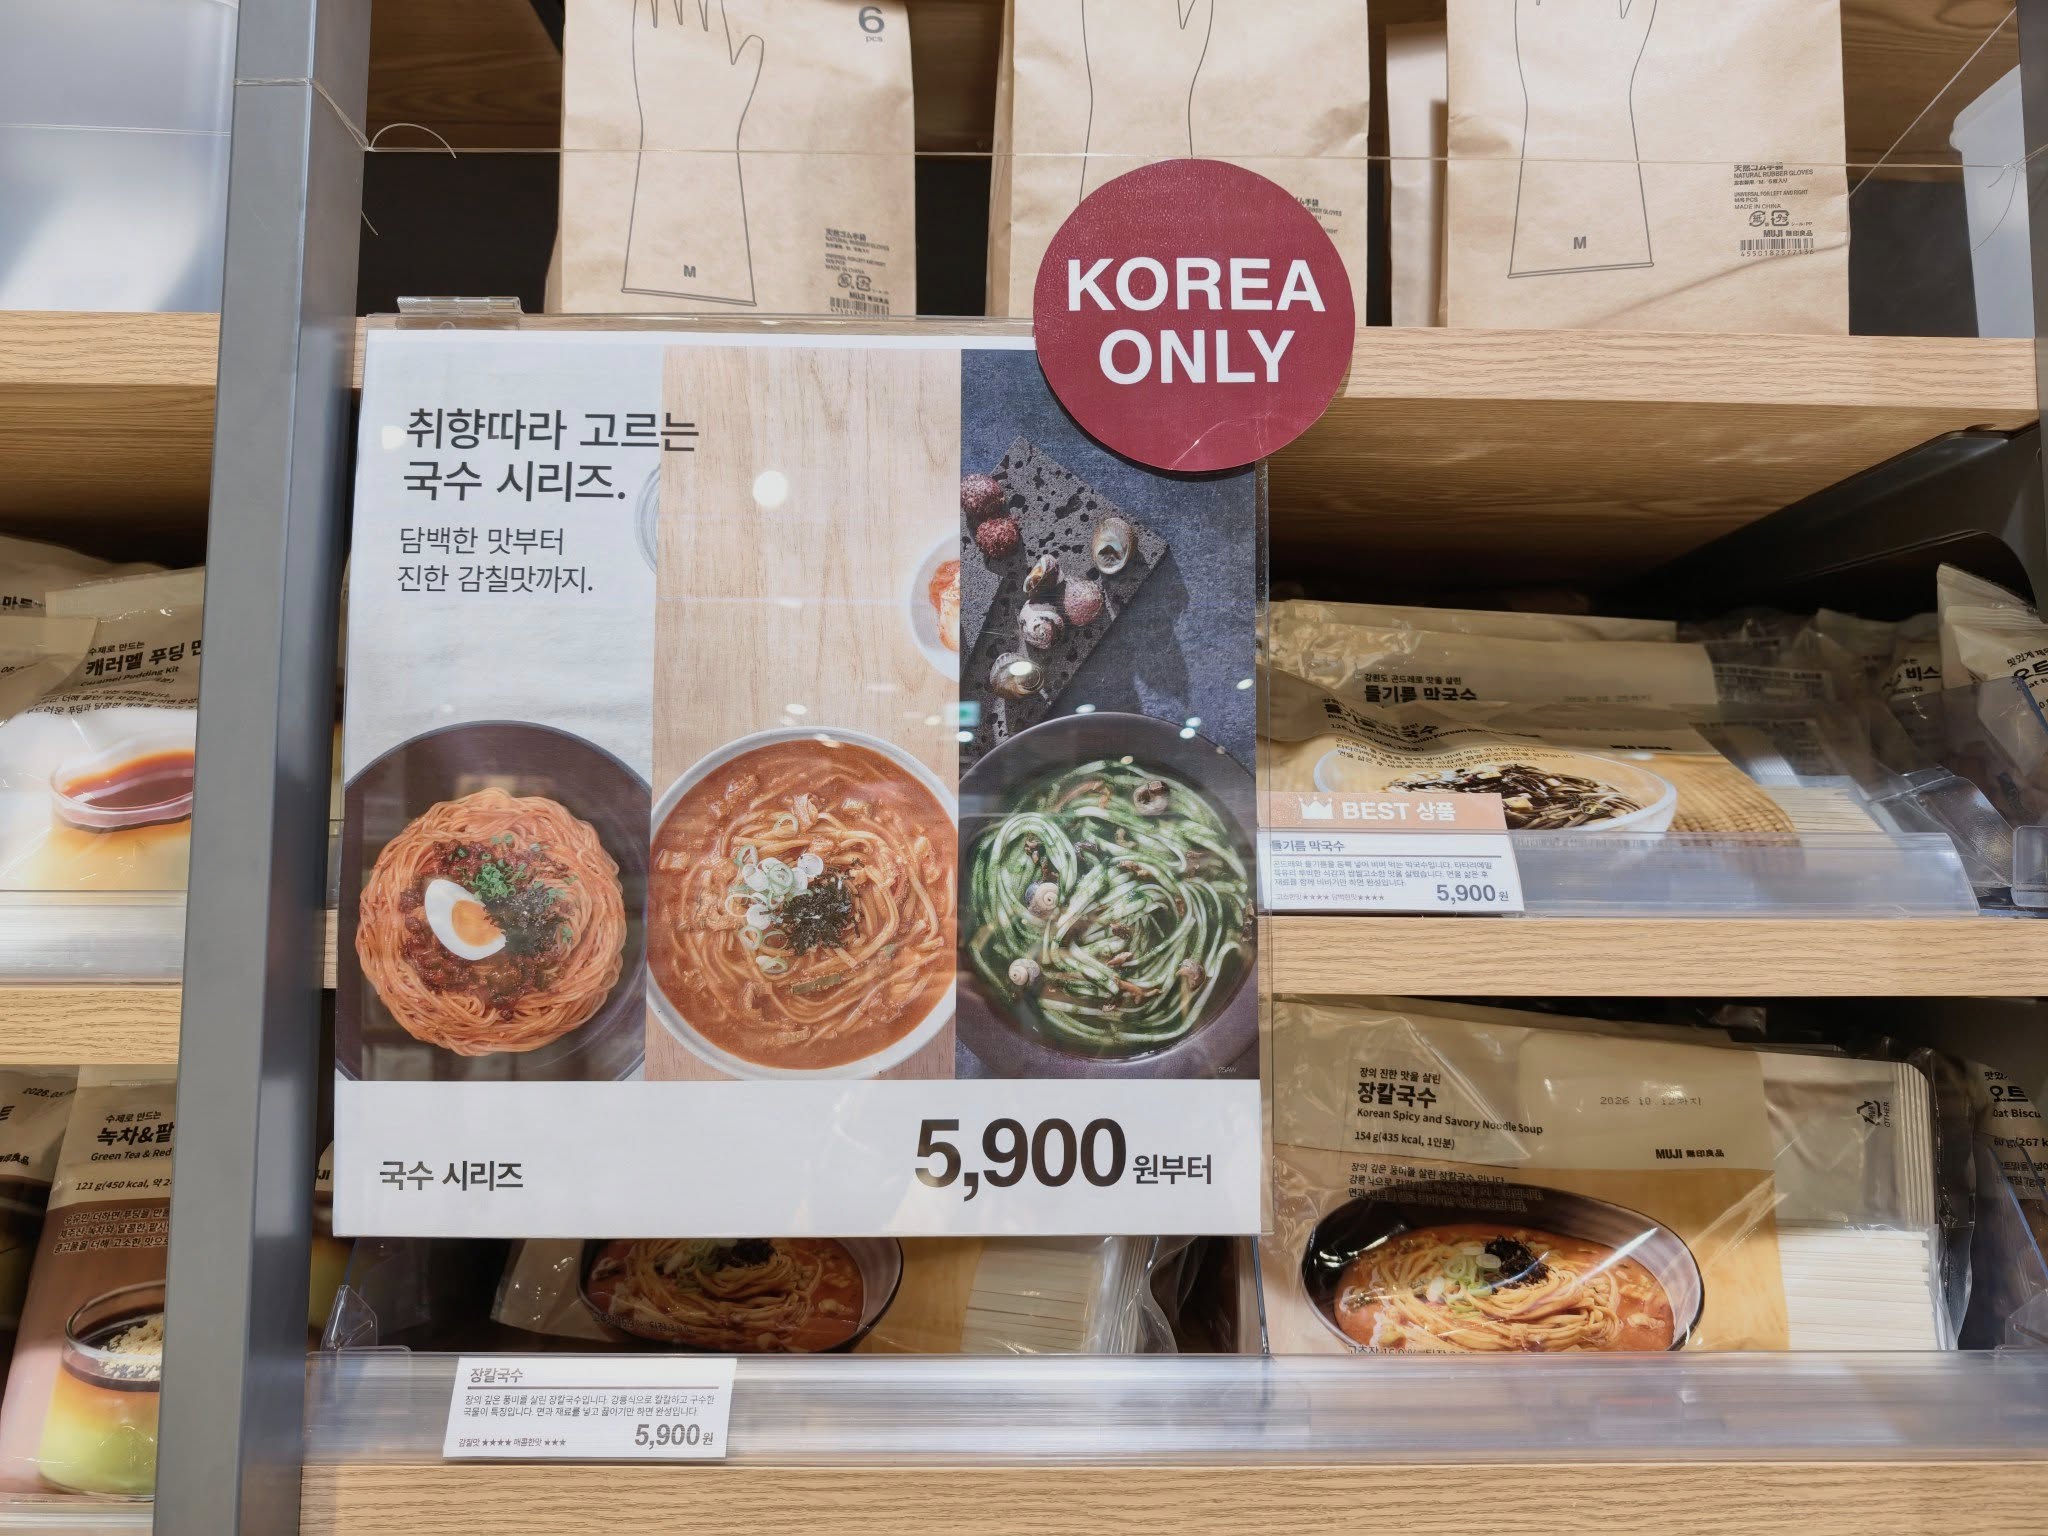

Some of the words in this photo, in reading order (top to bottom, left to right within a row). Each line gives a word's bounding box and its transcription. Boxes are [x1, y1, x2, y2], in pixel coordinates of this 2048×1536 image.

[858, 6, 885, 34] 6
[1762, 170, 1789, 178] RUBBER
[1763, 230, 1783, 238] MUJI
[1573, 236, 1587, 250] M
[683, 265, 697, 278] M
[1068, 256, 1326, 312] KOREA
[1098, 329, 1296, 385] ONLY
[406, 408, 568, 450] 취향따라
[580, 412, 700, 452] 고르는
[404, 461, 483, 502] 국수
[496, 460, 626, 502] 시리즈.
[400, 526, 479, 556] 담백한
[488, 527, 564, 556] 맛부터
[398, 564, 450, 593] 진한
[457, 566, 594, 594] 감칠맛까지.
[88, 644, 116, 656] 수제로
[118, 641, 145, 652] 만드는
[86, 652, 144, 676] 캐러멜
[149, 642, 185, 665] 푸딩
[2006, 650, 2035, 668] 맛있게
[122, 670, 164, 680] Pudding
[166, 666, 180, 674] Kit
[1364, 673, 1389, 682] 강원도
[1390, 674, 1424, 684] 곤드레로
[1426, 676, 1442, 685] 맛을
[1445, 676, 1462, 686] 살린
[1364, 684, 1418, 704] 들기름
[1423, 687, 1478, 701] 막국수
[1342, 800, 1410, 820] BEST
[1416, 801, 1456, 822] 상품
[1272, 840, 1306, 852] 들기름
[1309, 840, 1345, 852] 막국수
[1360, 1067, 1377, 1078] 장의
[1380, 1068, 1398, 1080] 진한
[1400, 1070, 1420, 1082] 맛을
[1422, 1072, 1441, 1085] 살린
[1357, 1081, 1437, 1109] 장칼국수
[1600, 1096, 1630, 1106] 2026
[1989, 1085, 2029, 1102] 오트
[106, 1114, 134, 1124] 수제로
[136, 1110, 162, 1122] 만드는
[1993, 1108, 2009, 1118] Oat
[1356, 1108, 1390, 1118] Korean
[1392, 1110, 1420, 1124] Spicy
[1422, 1114, 1442, 1124] and
[1444, 1116, 1480, 1130] Savory
[1482, 1120, 1517, 1132] Noodle
[1518, 1123, 1544, 1136] Soup
[96, 1121, 175, 1146] 녹차&팥
[1354, 1131, 1371, 1140] 154
[1372, 1132, 1400, 1143] g(435
[1401, 1134, 1424, 1146] kcal,
[1426, 1136, 1456, 1150] 1인분)
[91, 1152, 122, 1161] Green
[124, 1150, 140, 1159] Tea
[142, 1150, 151, 1158] &
[152, 1148, 172, 1158] Red
[1656, 1148, 1683, 1160] MUJI
[1686, 1149, 1725, 1158] 無印良品
[378, 1160, 434, 1191] 국수
[442, 1160, 525, 1192] 시리즈
[1418, 1168, 1436, 1180] 살린
[76, 1182, 94, 1190] 121
[126, 1179, 150, 1189] kcal,
[152, 1178, 163, 1188] 약
[92, 1210, 121, 1222] 더하면
[90, 1239, 110, 1249] 더해
[114, 1238, 142, 1248] 고소한
[470, 1367, 524, 1384] 장칼국수
[464, 1395, 482, 1405] 장의
[484, 1395, 502, 1405] 깊은
[530, 1395, 547, 1405] 살린
[690, 1395, 715, 1405] 구수한
[464, 1406, 488, 1417] 국물이
[490, 1406, 533, 1417] 특징입니다.
[536, 1407, 554, 1417] 면과
[555, 1407, 580, 1418] 재료를
[636, 1408, 654, 1417] 하면
